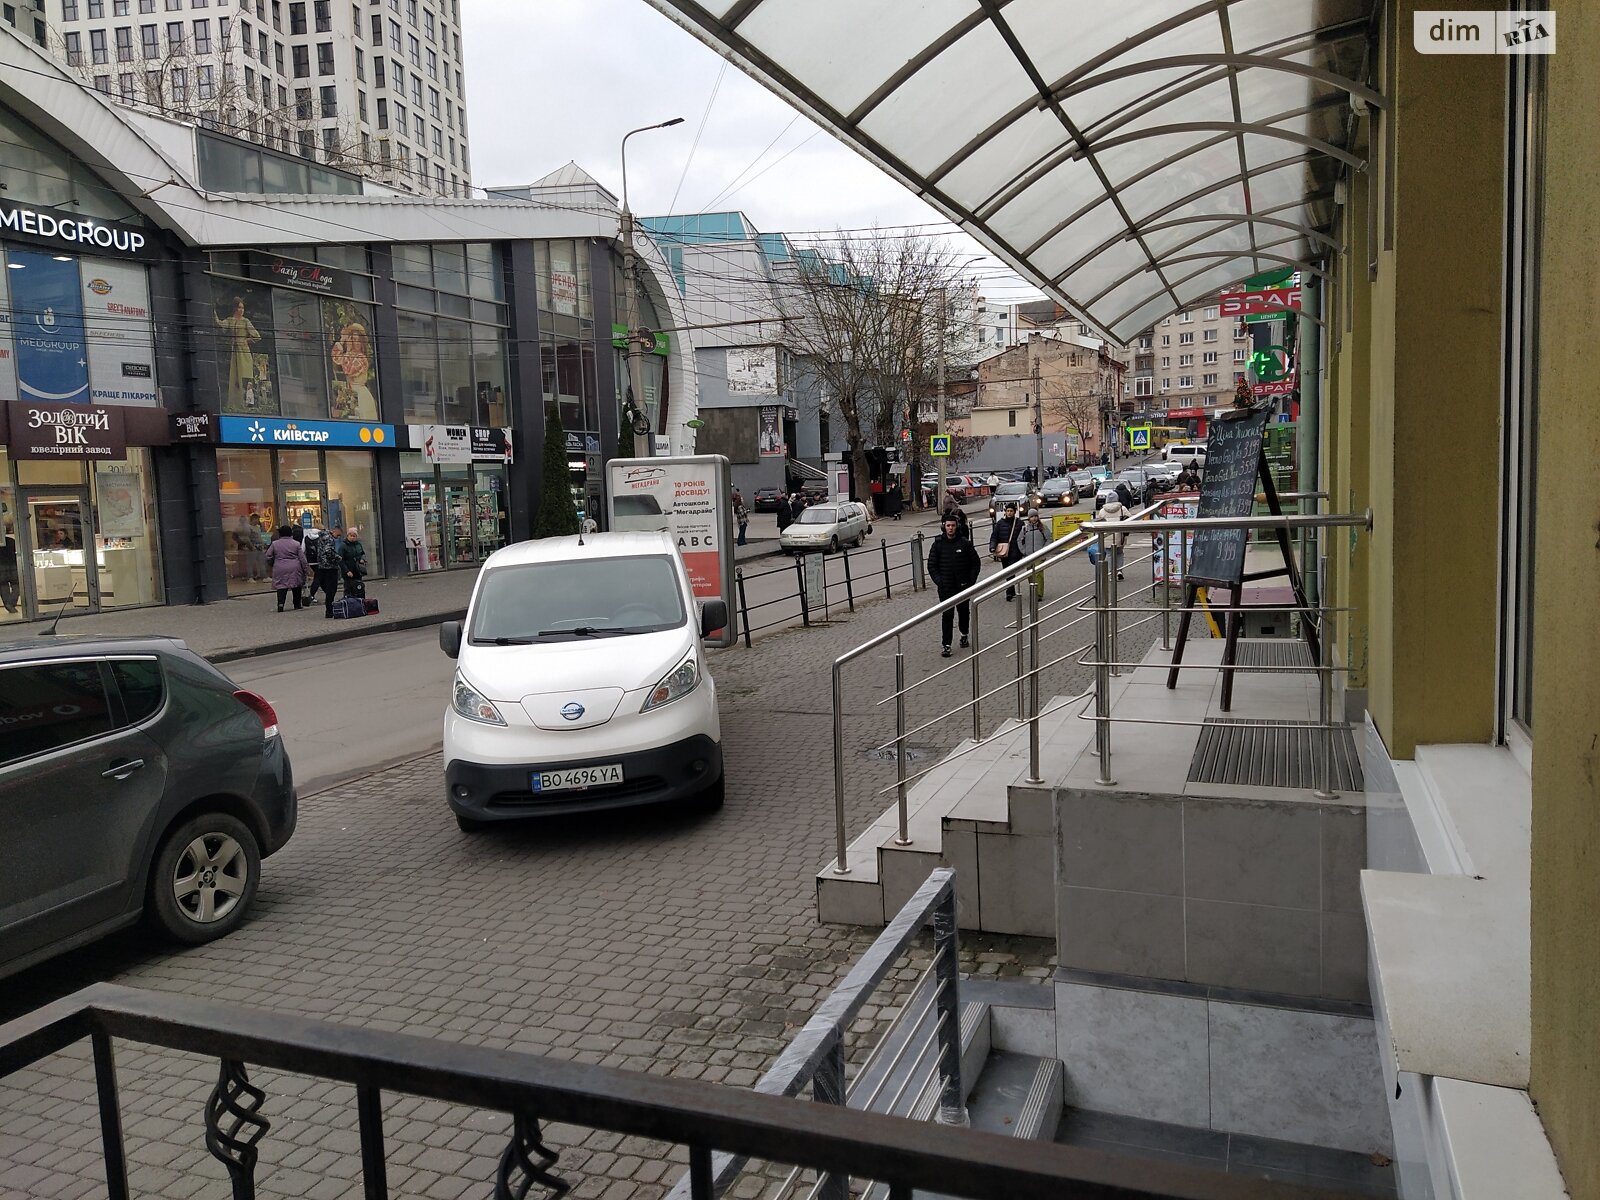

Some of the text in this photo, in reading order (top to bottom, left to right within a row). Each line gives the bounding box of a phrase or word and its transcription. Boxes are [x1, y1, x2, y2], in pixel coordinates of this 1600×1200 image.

[0, 207, 146, 252] MEDGROUP
[1254, 383, 1294, 394] SPAR
[92, 389, 157, 400] КРАЩЕ ЛІКАРЯМ
[28, 408, 110, 430] ЗОЛОТИЙ
[55, 426, 89, 444] ВІК
[273, 424, 330, 442] КИЇВСТАР
[475, 429, 490, 438] SHOP
[31, 445, 112, 456] ювелірний завод
[683, 480, 706, 488] РОКІВ
[674, 488, 710, 497] ДОСВІДУ!
[672, 500, 710, 508] Автошкола
[678, 535, 713, 547] A B C
[541, 766, 620, 788] BO 4696 YA
